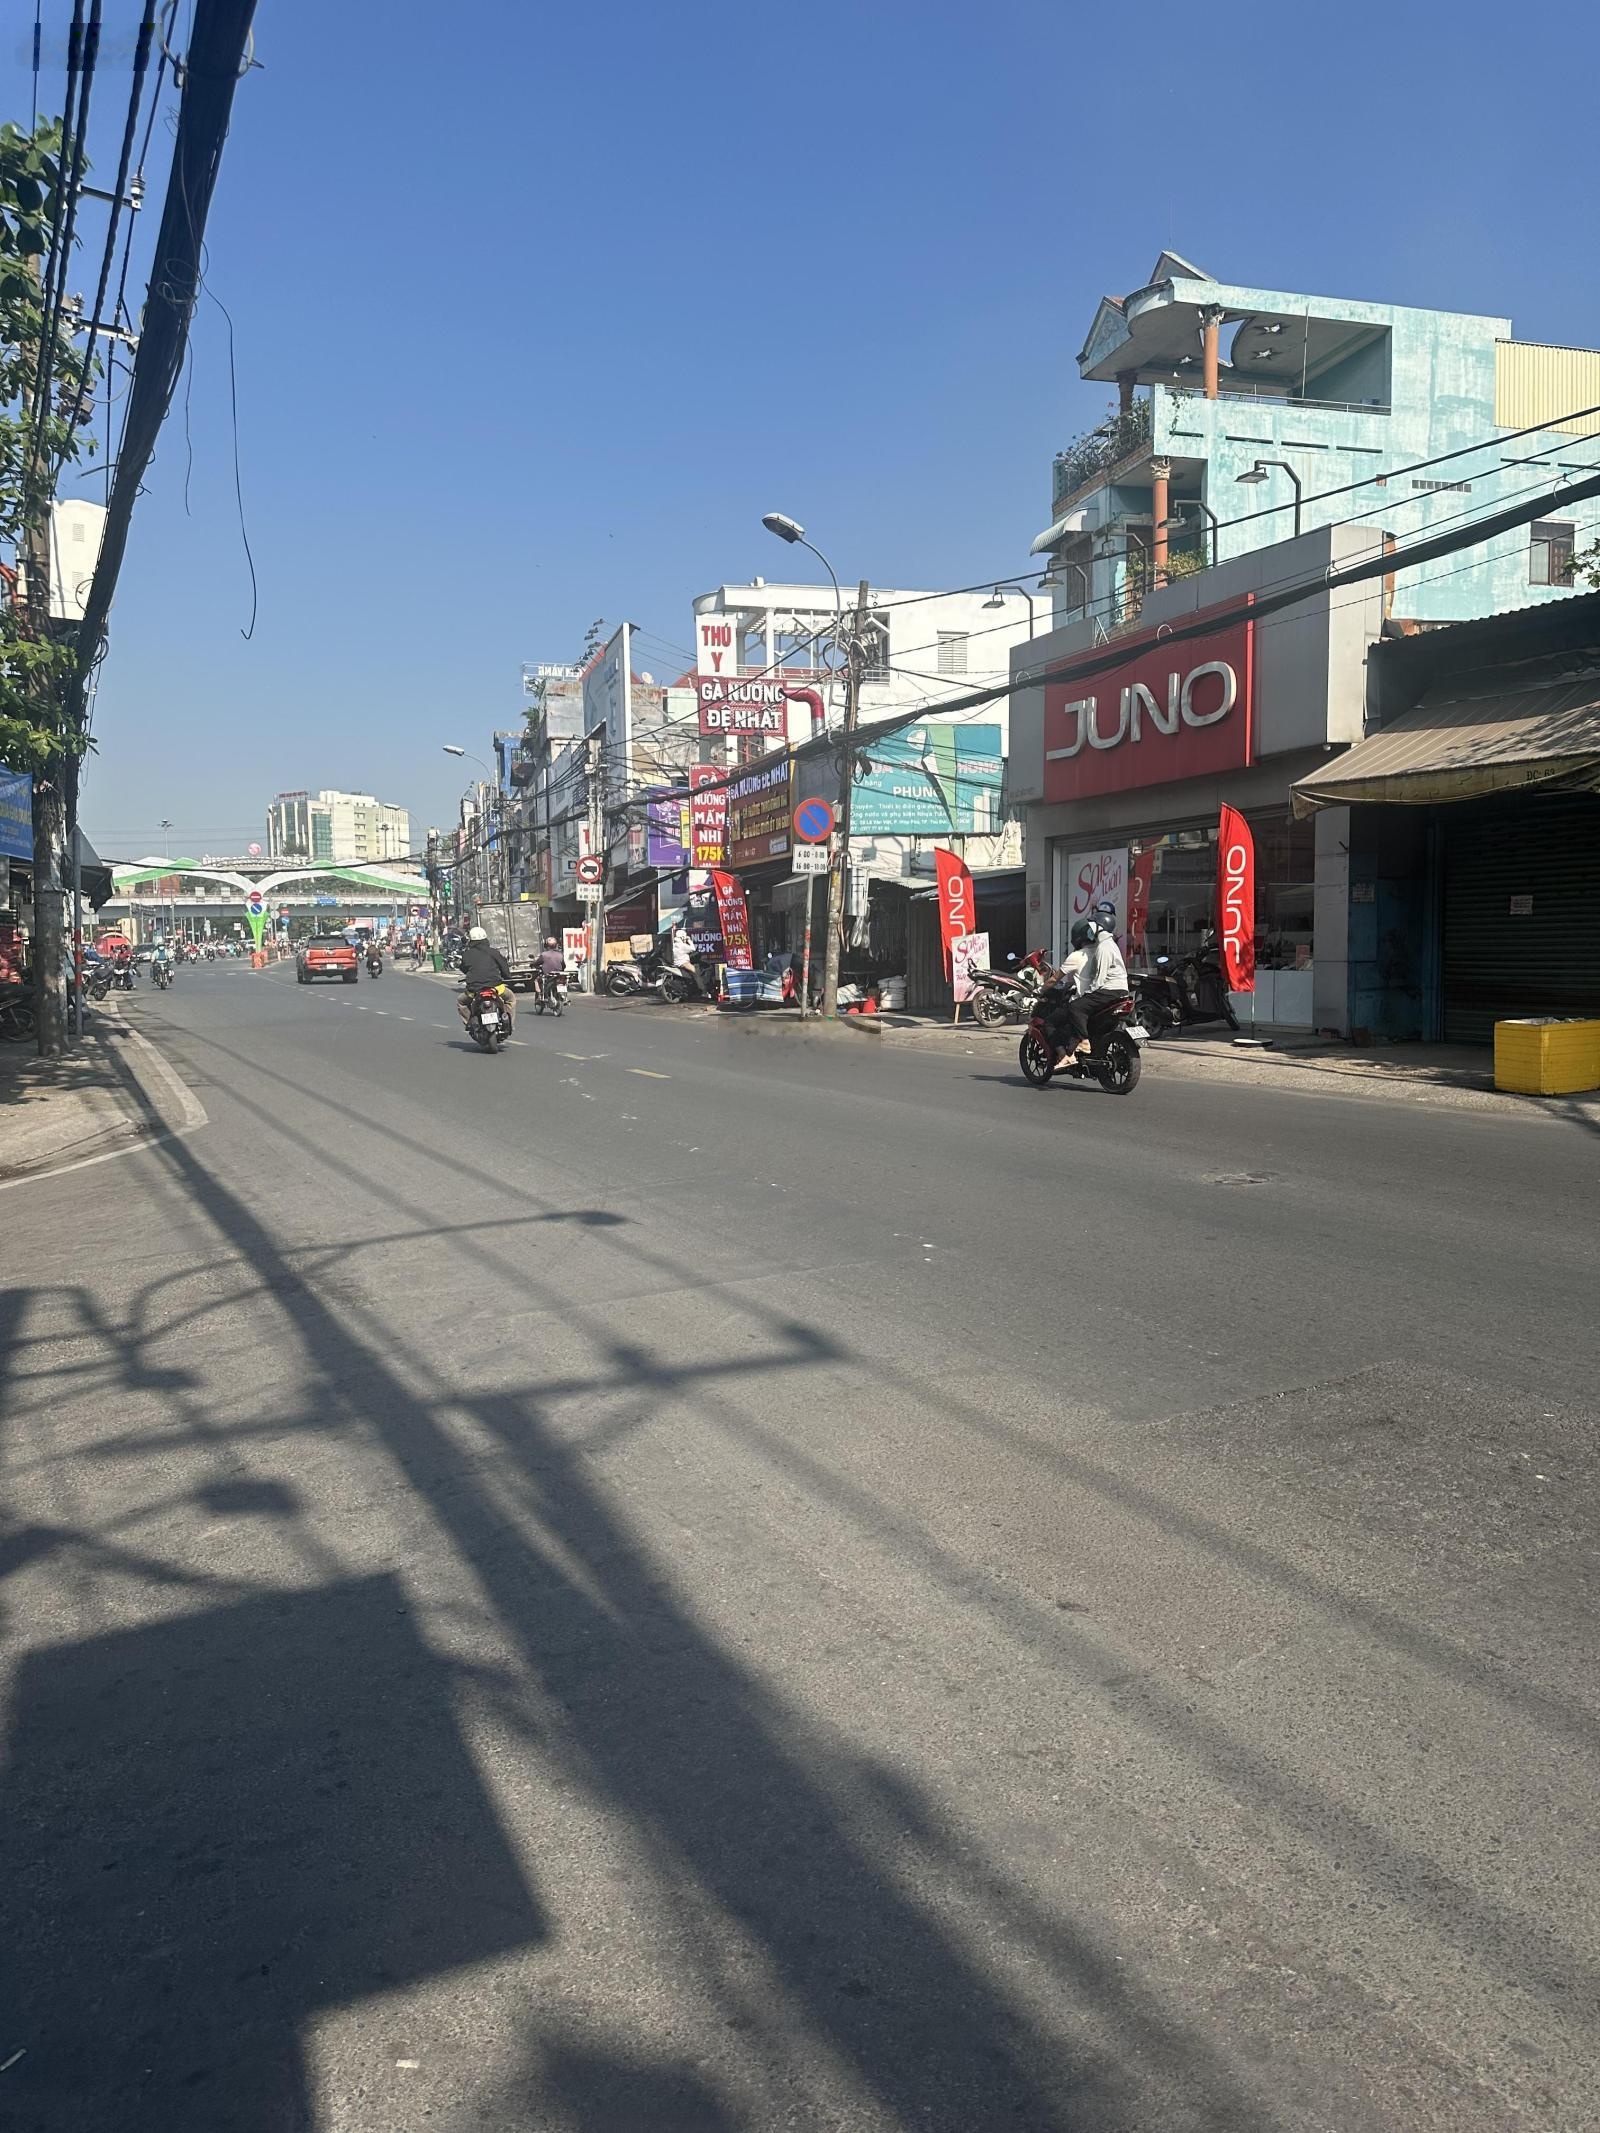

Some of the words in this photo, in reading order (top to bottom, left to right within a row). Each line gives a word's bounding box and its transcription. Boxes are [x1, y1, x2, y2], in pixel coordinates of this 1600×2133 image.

[701, 623, 732, 647] THÚ
[711, 652, 723, 673] Y
[701, 678, 724, 701] GÀ
[707, 705, 733, 732] ĐỆ
[1046, 661, 1238, 760] JUNO
[694, 791, 726, 806] NƯỚNG
[696, 846, 726, 862] 175K
[1074, 855, 1112, 914] Sale
[1223, 844, 1247, 964] JUNO
[691, 931, 722, 942] NƯỚNG
[723, 934, 748, 946] 175K
